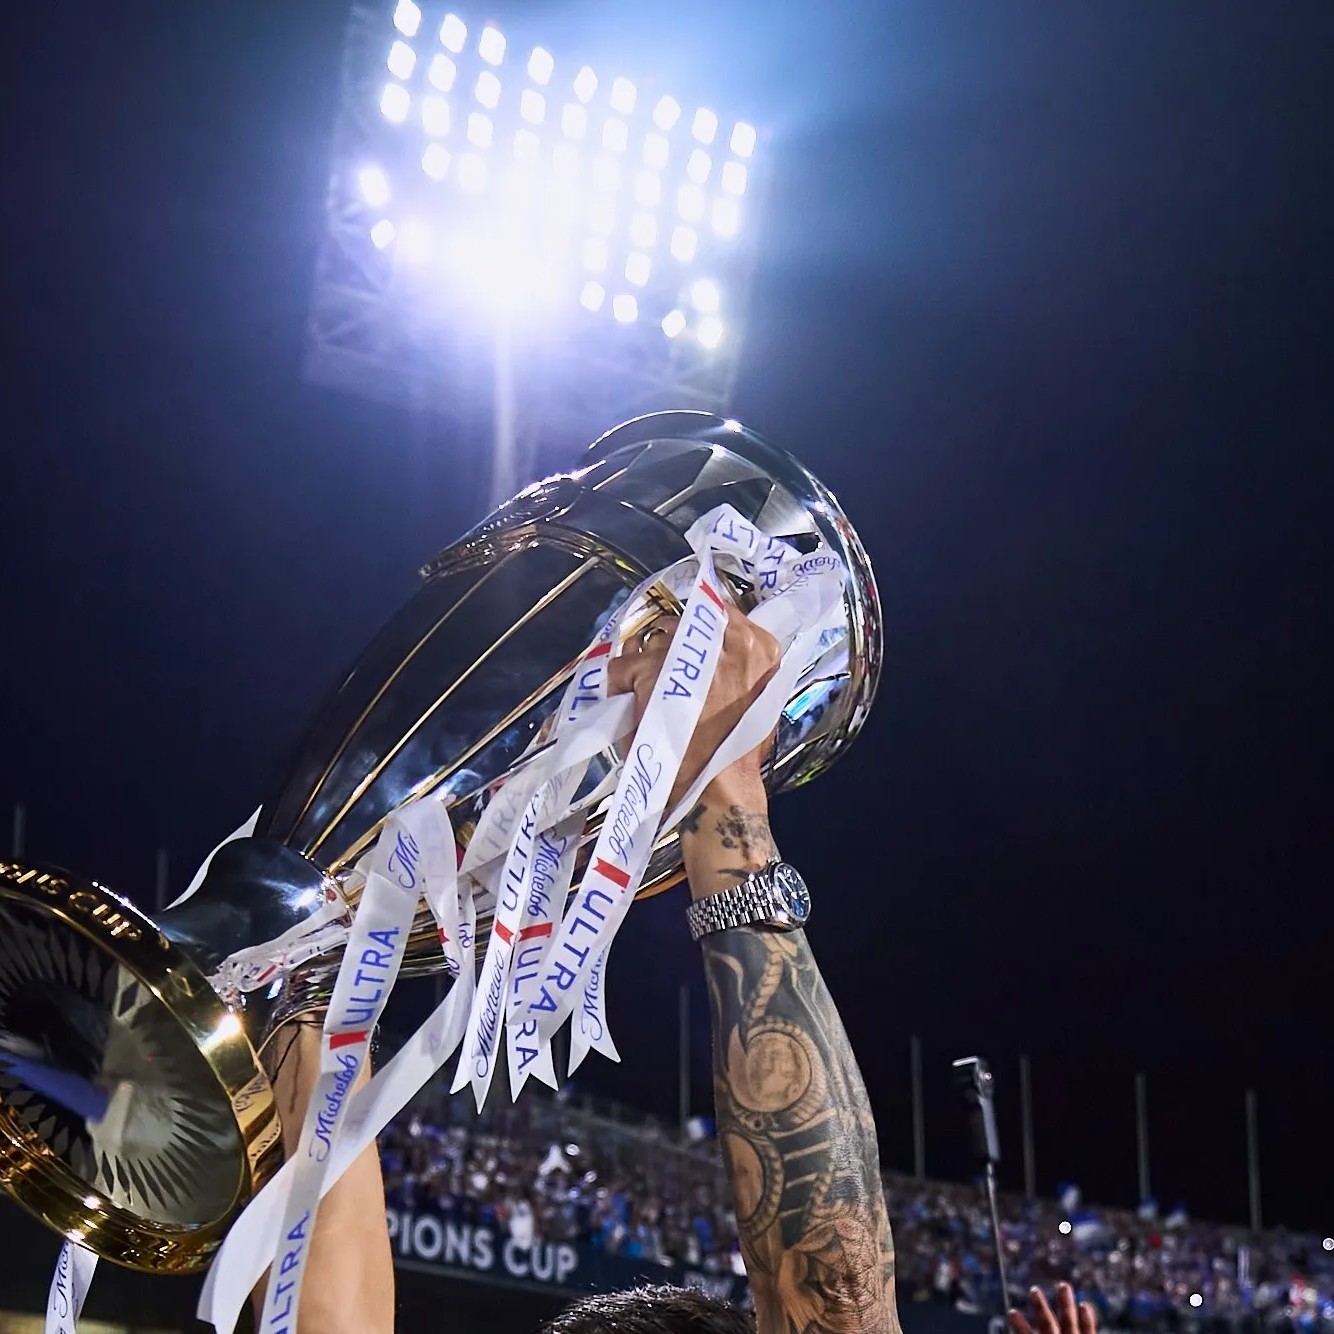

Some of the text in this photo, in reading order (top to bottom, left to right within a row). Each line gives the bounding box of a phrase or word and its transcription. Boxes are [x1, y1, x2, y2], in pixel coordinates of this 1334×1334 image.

[663, 603, 718, 700] ULTRA
[598, 743, 661, 867] Michelob
[528, 828, 567, 919] Michelob
[342, 926, 400, 1027] ULTRA
[530, 889, 613, 1013] ULTRA
[310, 1054, 358, 1163] Michelob
[503, 1234, 579, 1284] CUP
